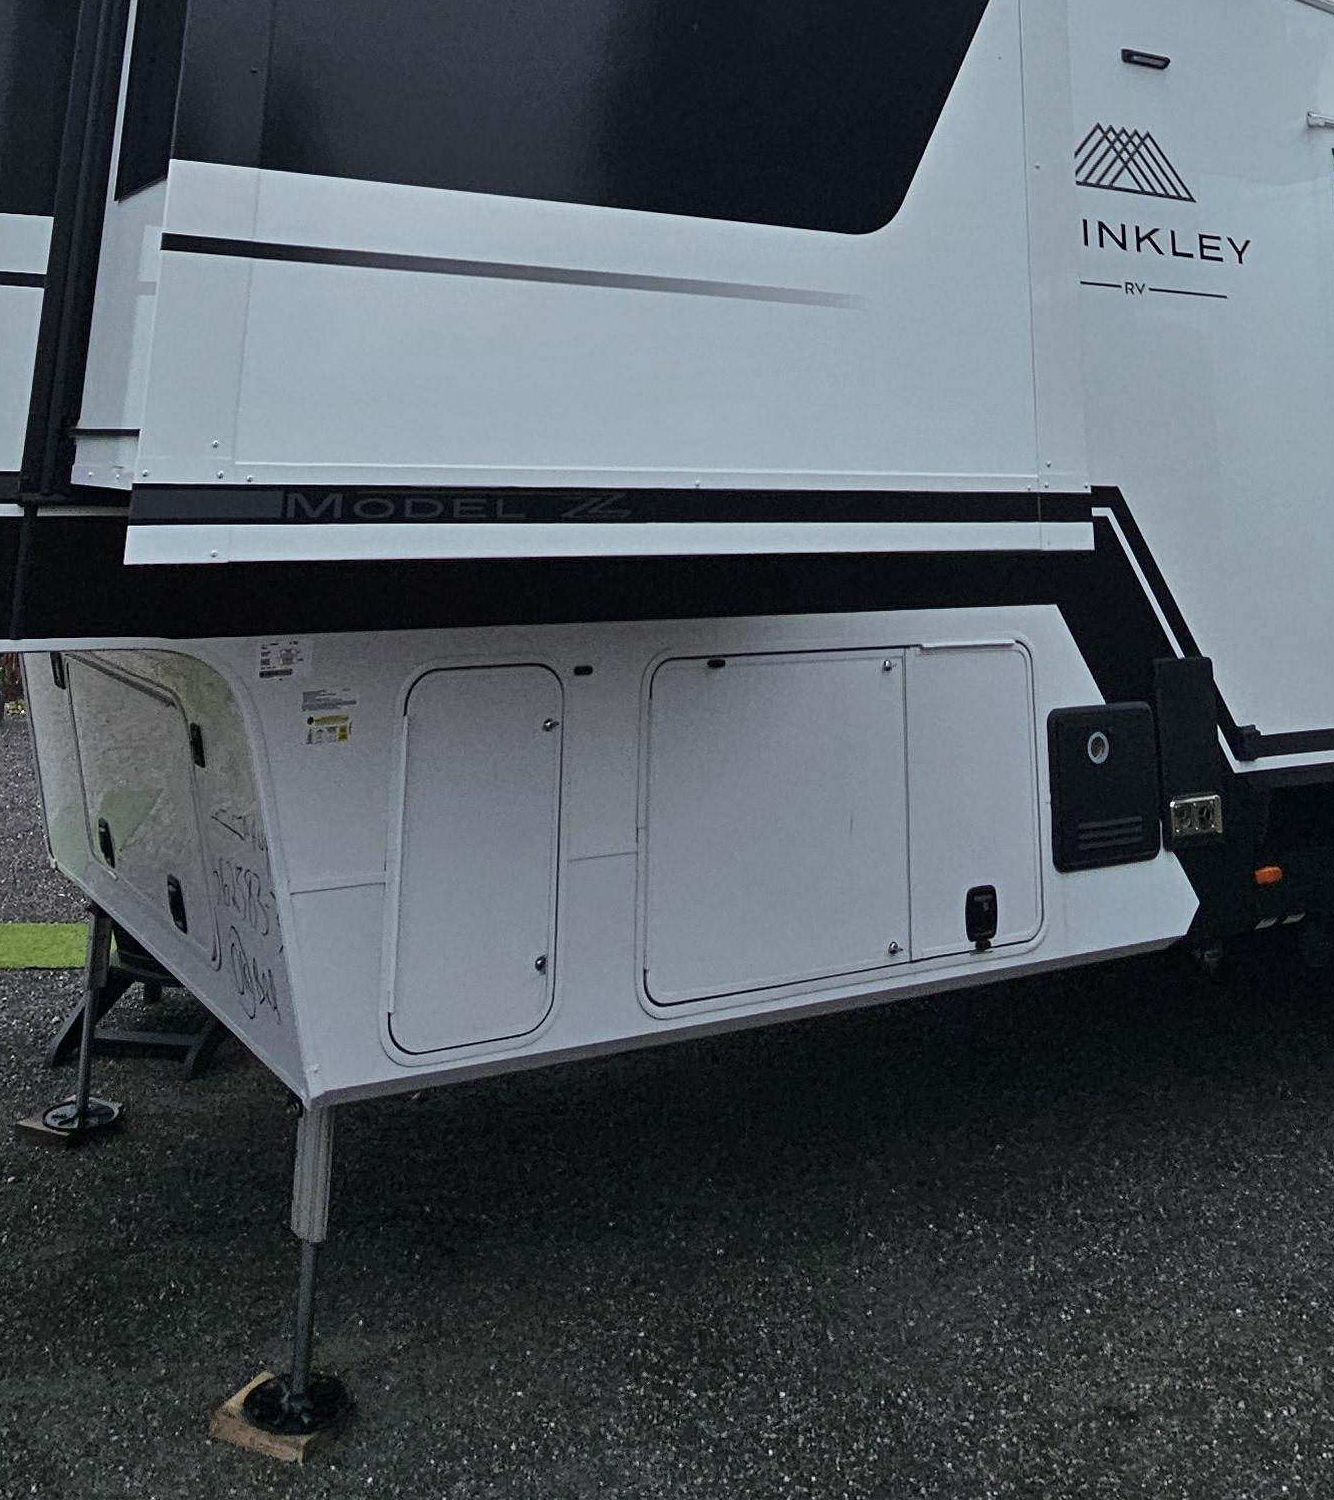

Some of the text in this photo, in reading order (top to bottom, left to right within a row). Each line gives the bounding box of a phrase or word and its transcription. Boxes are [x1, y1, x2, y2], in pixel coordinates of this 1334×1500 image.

[1082, 218, 1251, 265] INKLEY
[1124, 281, 1146, 295] RV
[285, 492, 527, 519] MODEL
